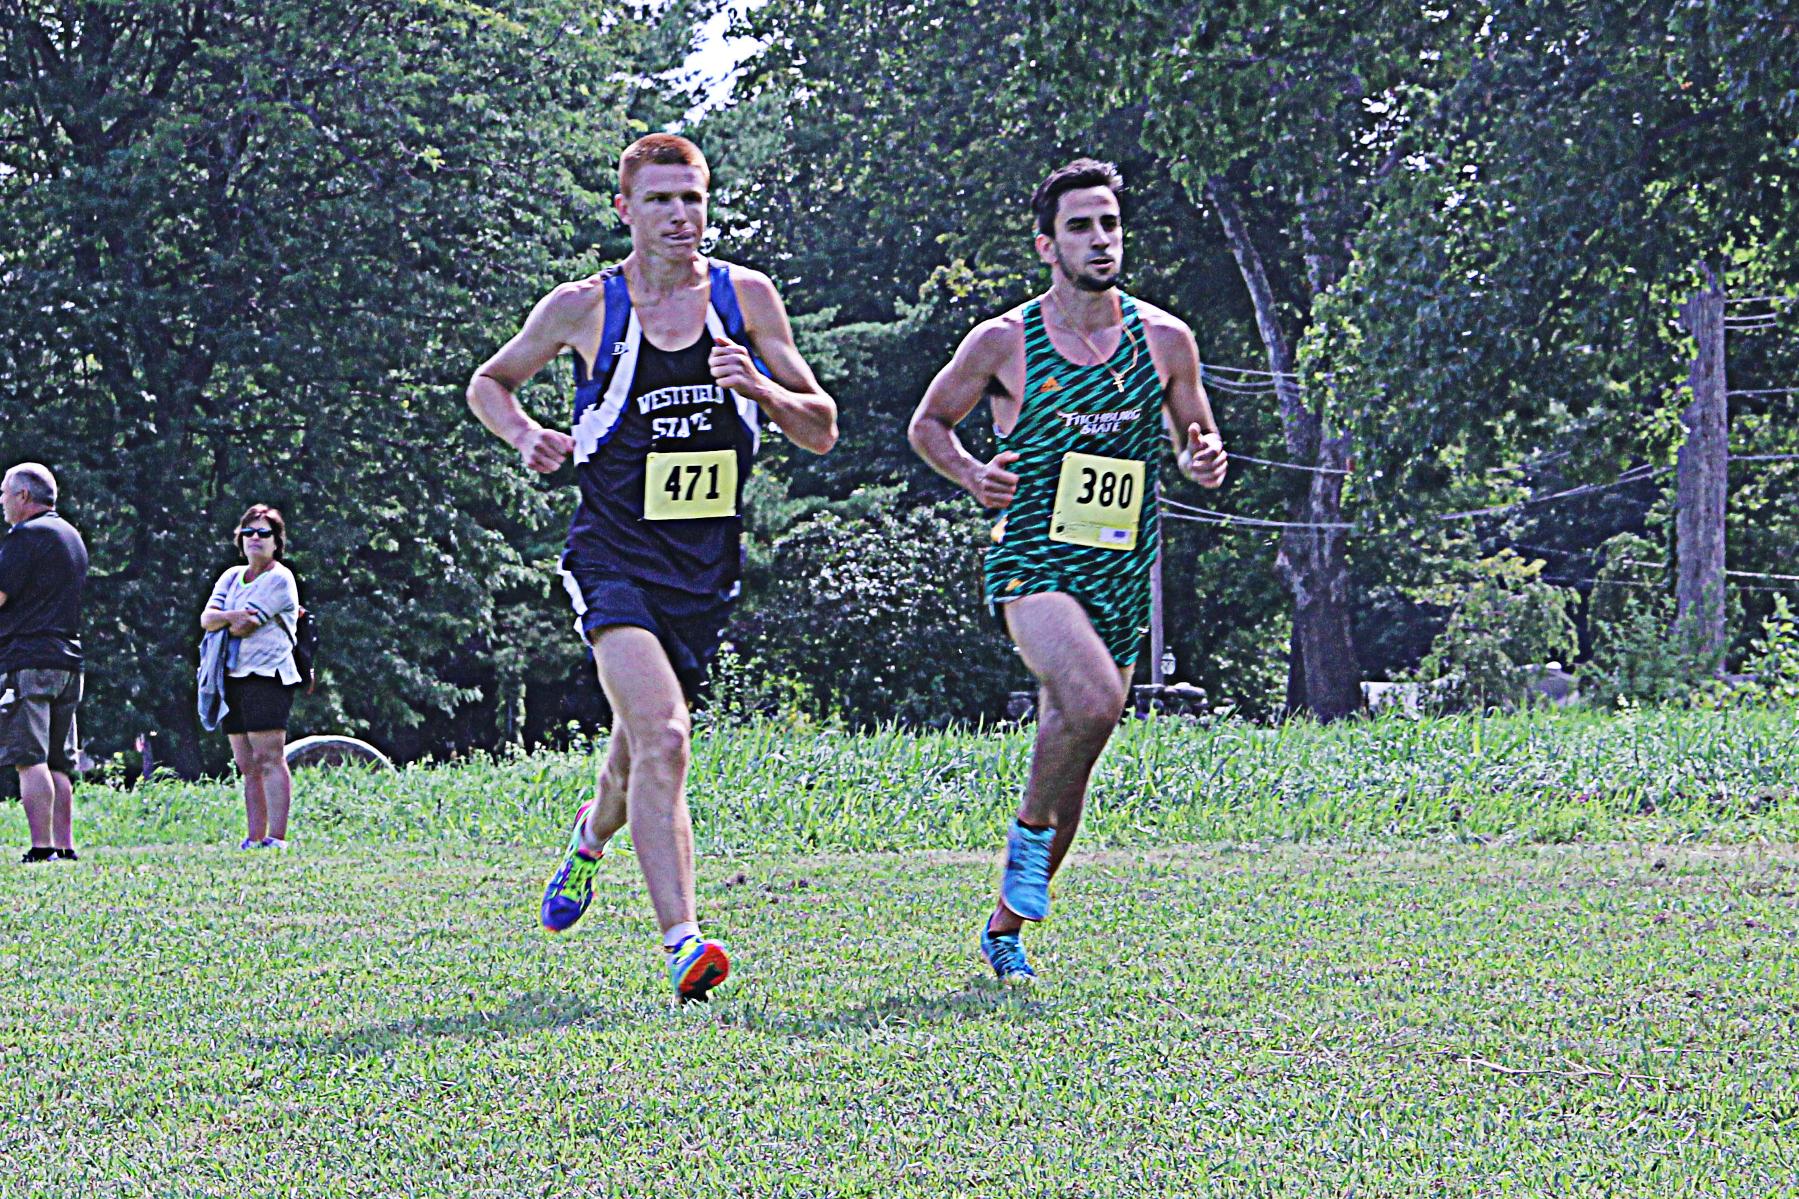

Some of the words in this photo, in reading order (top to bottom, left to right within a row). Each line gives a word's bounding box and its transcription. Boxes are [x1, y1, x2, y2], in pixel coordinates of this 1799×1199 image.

[652, 408, 712, 440] STATE
[664, 464, 719, 501] 471
[1076, 467, 1134, 509] 380
